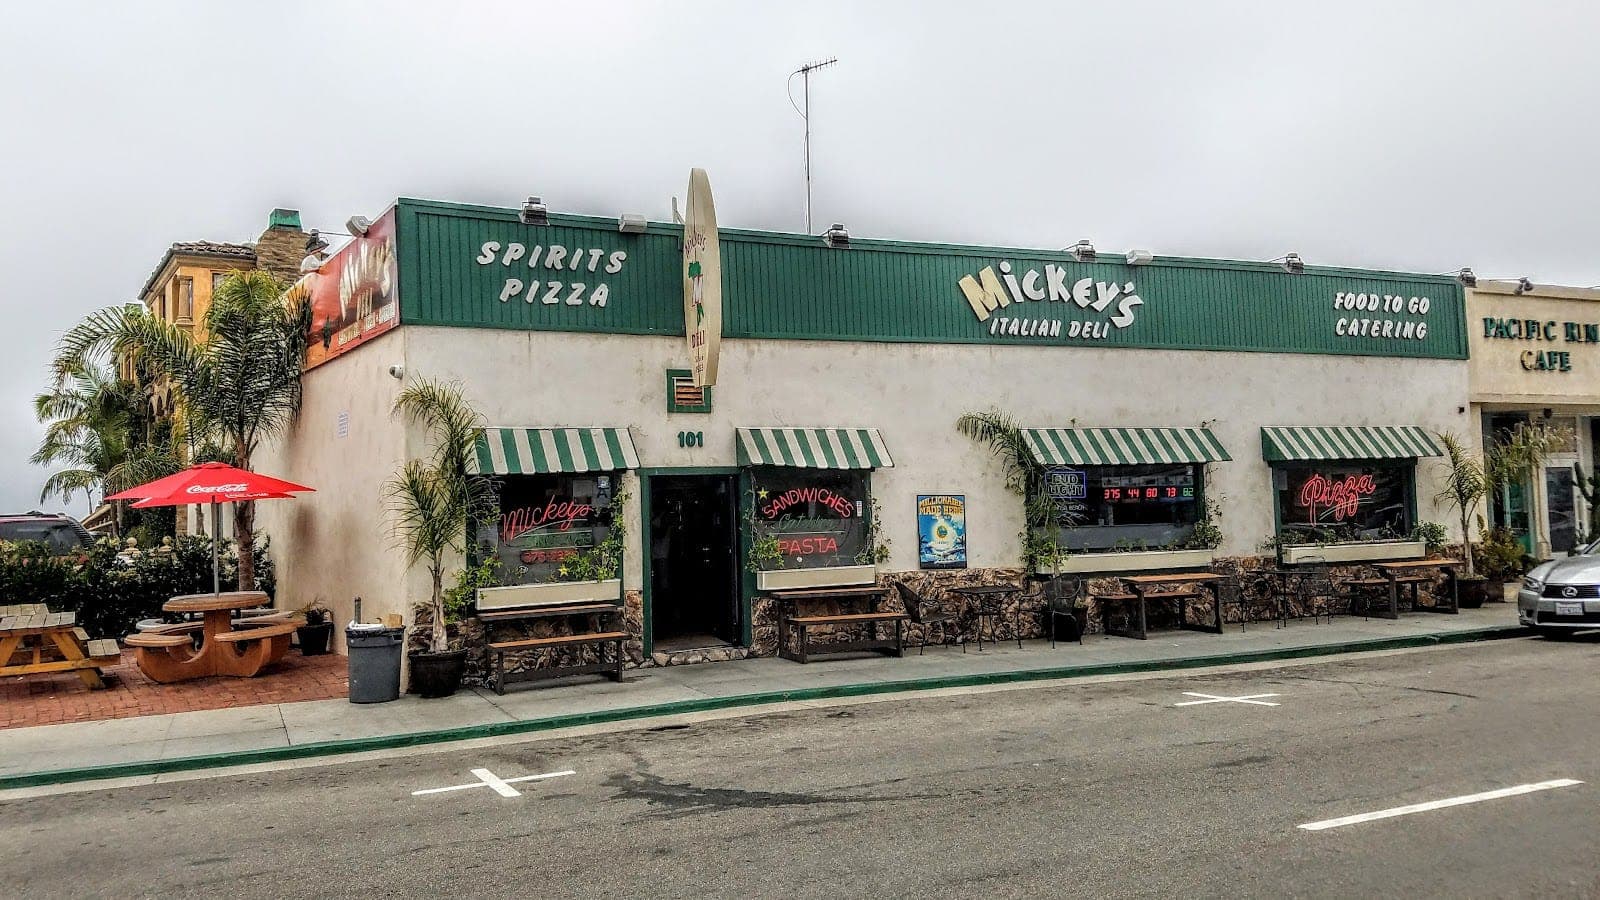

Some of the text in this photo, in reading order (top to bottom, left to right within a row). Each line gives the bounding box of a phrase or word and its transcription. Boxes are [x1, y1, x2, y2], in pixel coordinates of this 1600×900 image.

[476, 241, 627, 274] SPIRITS
[499, 278, 610, 308] PIZZA
[1334, 292, 1430, 315] FOOD TO GO
[691, 329, 705, 349] DELI
[990, 317, 1111, 339] ITALIAN DELI
[1335, 317, 1428, 341] CATERING
[1483, 317, 1557, 342] PACIFIC
[1520, 349, 1572, 372] CAFE
[677, 430, 704, 448] 101
[186, 483, 249, 495] Coca-Cola
[1049, 484, 1084, 496] LIGHT
[1051, 473, 1079, 485] BUD
[762, 487, 855, 519] SANDWICHES
[1104, 488, 1121, 499] 375
[1128, 488, 1140, 498] 44
[1166, 487, 1177, 498] 73
[1183, 487, 1194, 497] 82
[1301, 473, 1377, 528] Pizza
[777, 537, 838, 556] PASTA
